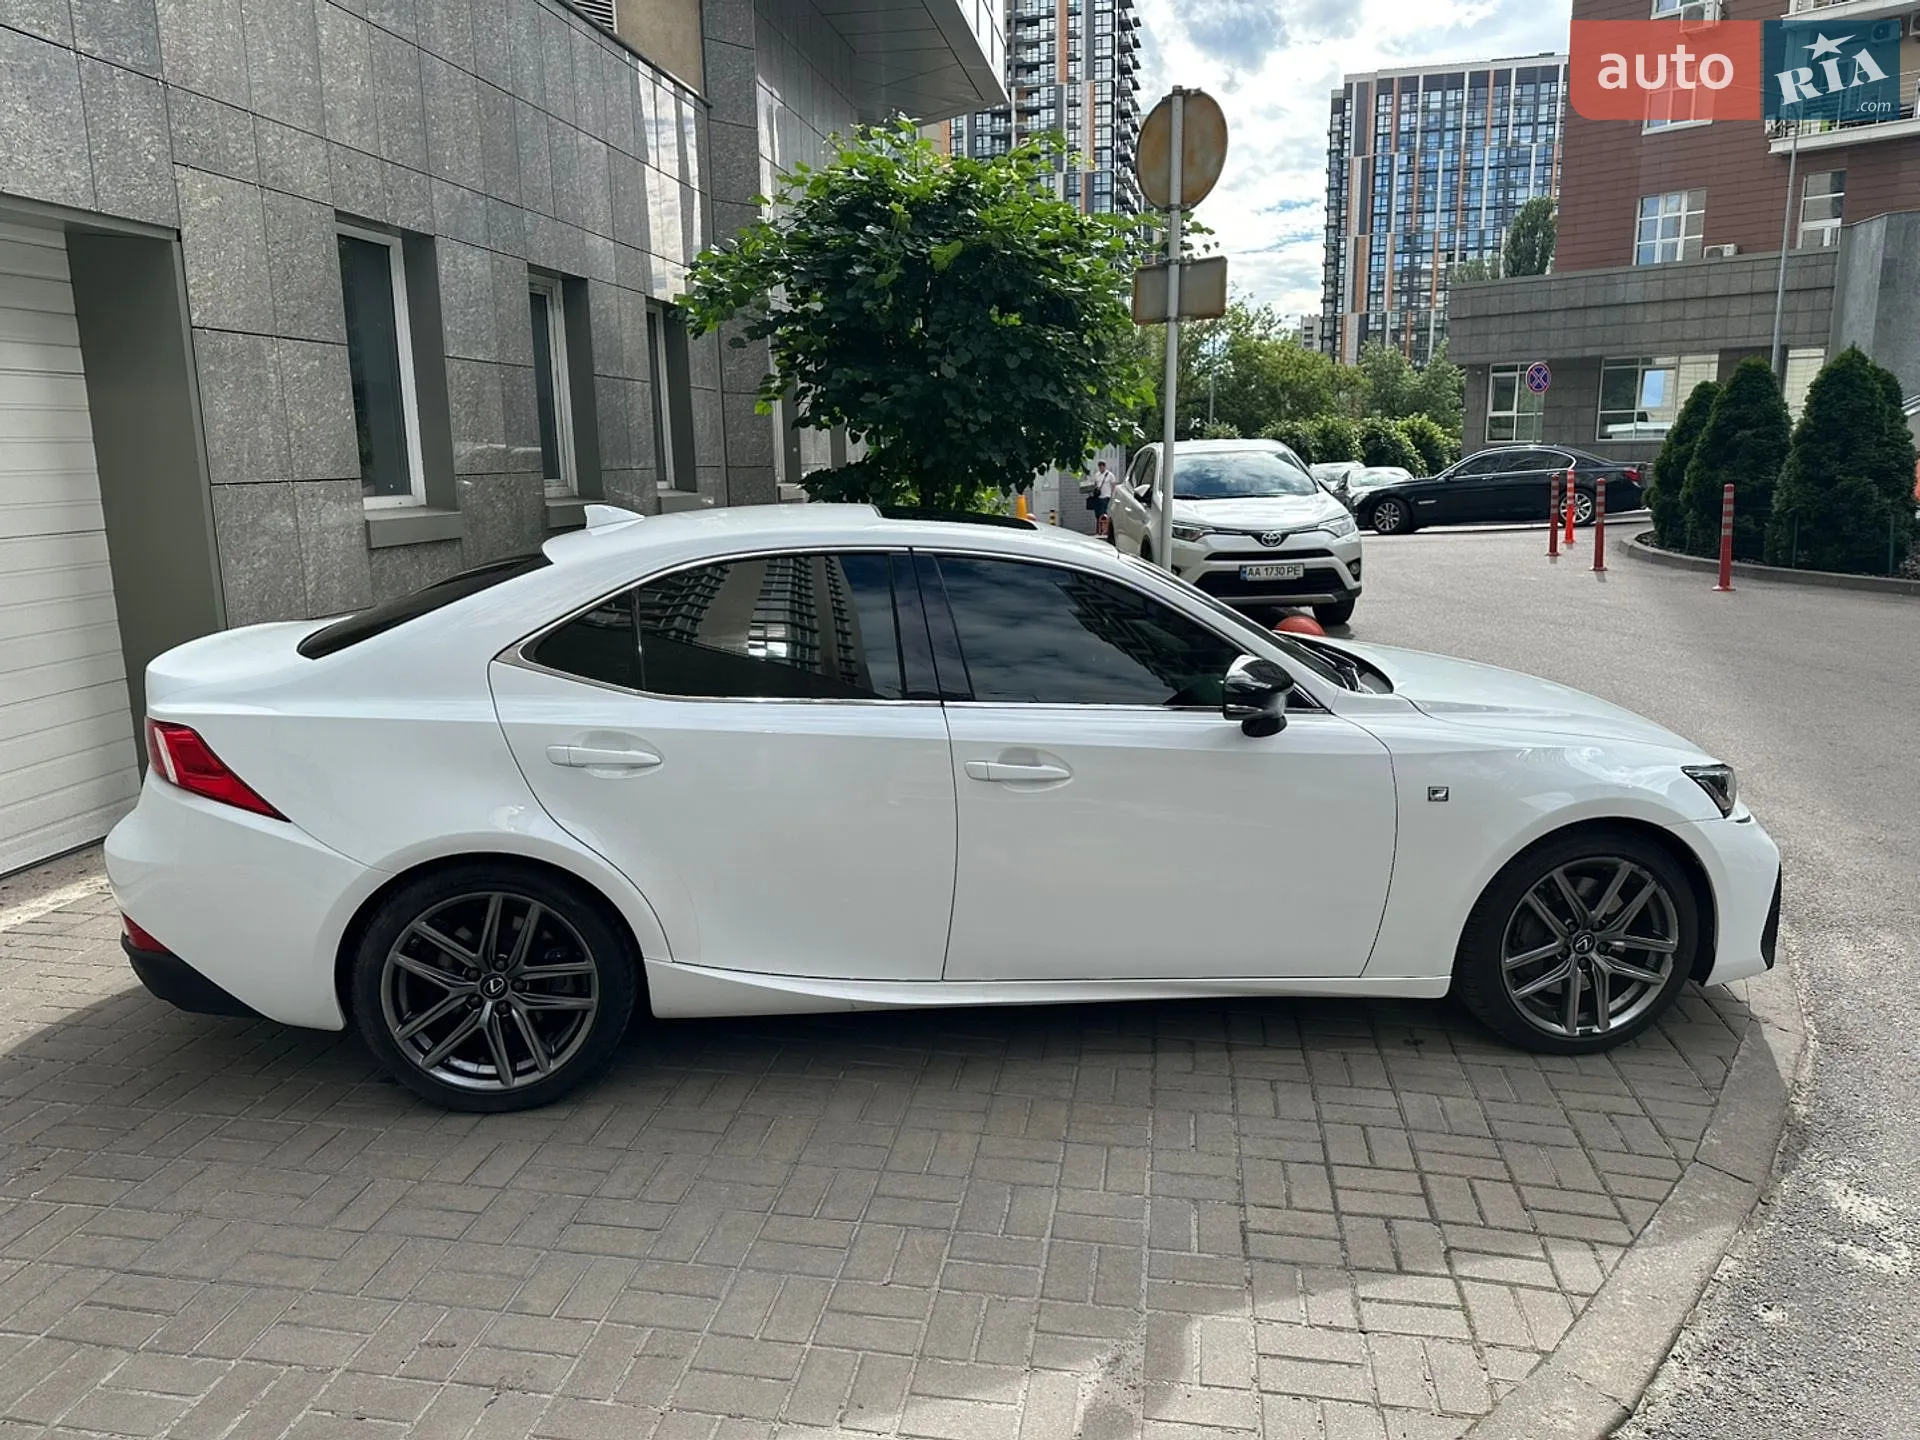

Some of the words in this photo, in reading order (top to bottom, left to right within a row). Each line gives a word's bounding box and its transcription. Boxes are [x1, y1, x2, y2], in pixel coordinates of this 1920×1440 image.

[1248, 567, 1261, 576] AA
[1264, 566, 1285, 576] 1730
[1287, 566, 1300, 576] PE
